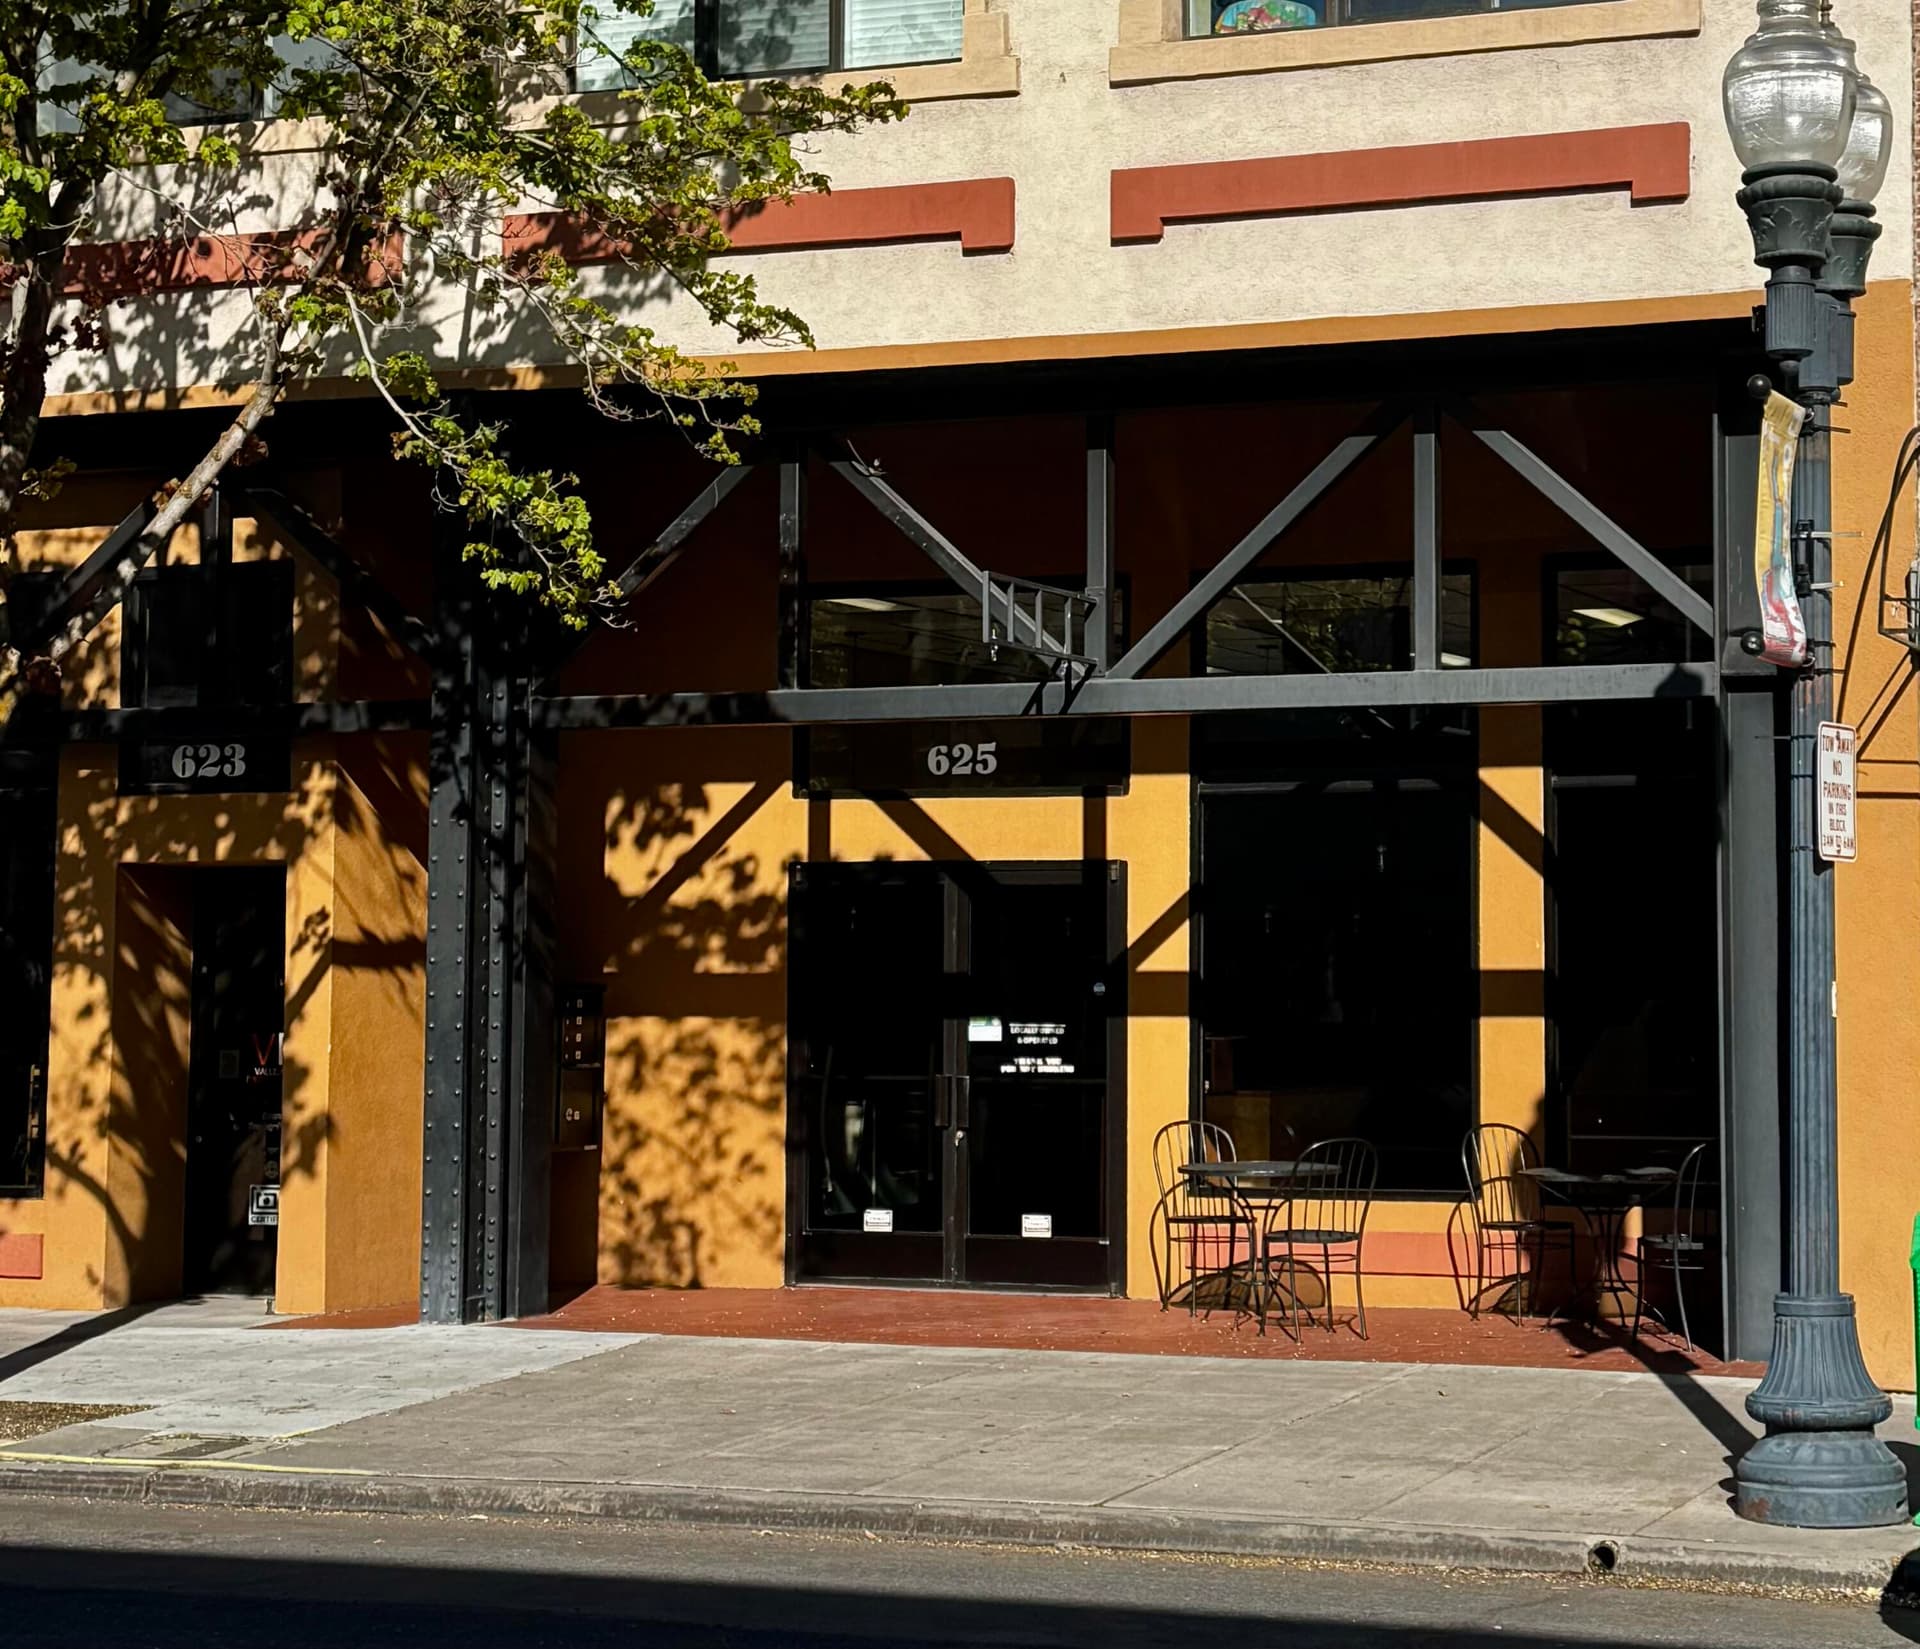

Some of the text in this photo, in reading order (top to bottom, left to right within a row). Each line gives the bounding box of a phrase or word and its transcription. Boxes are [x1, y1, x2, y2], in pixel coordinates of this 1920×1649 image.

[172, 744, 246, 778] 623
[927, 741, 998, 775] 625
[1832, 759, 1843, 776] NO
[1823, 781, 1852, 800] PARKING
